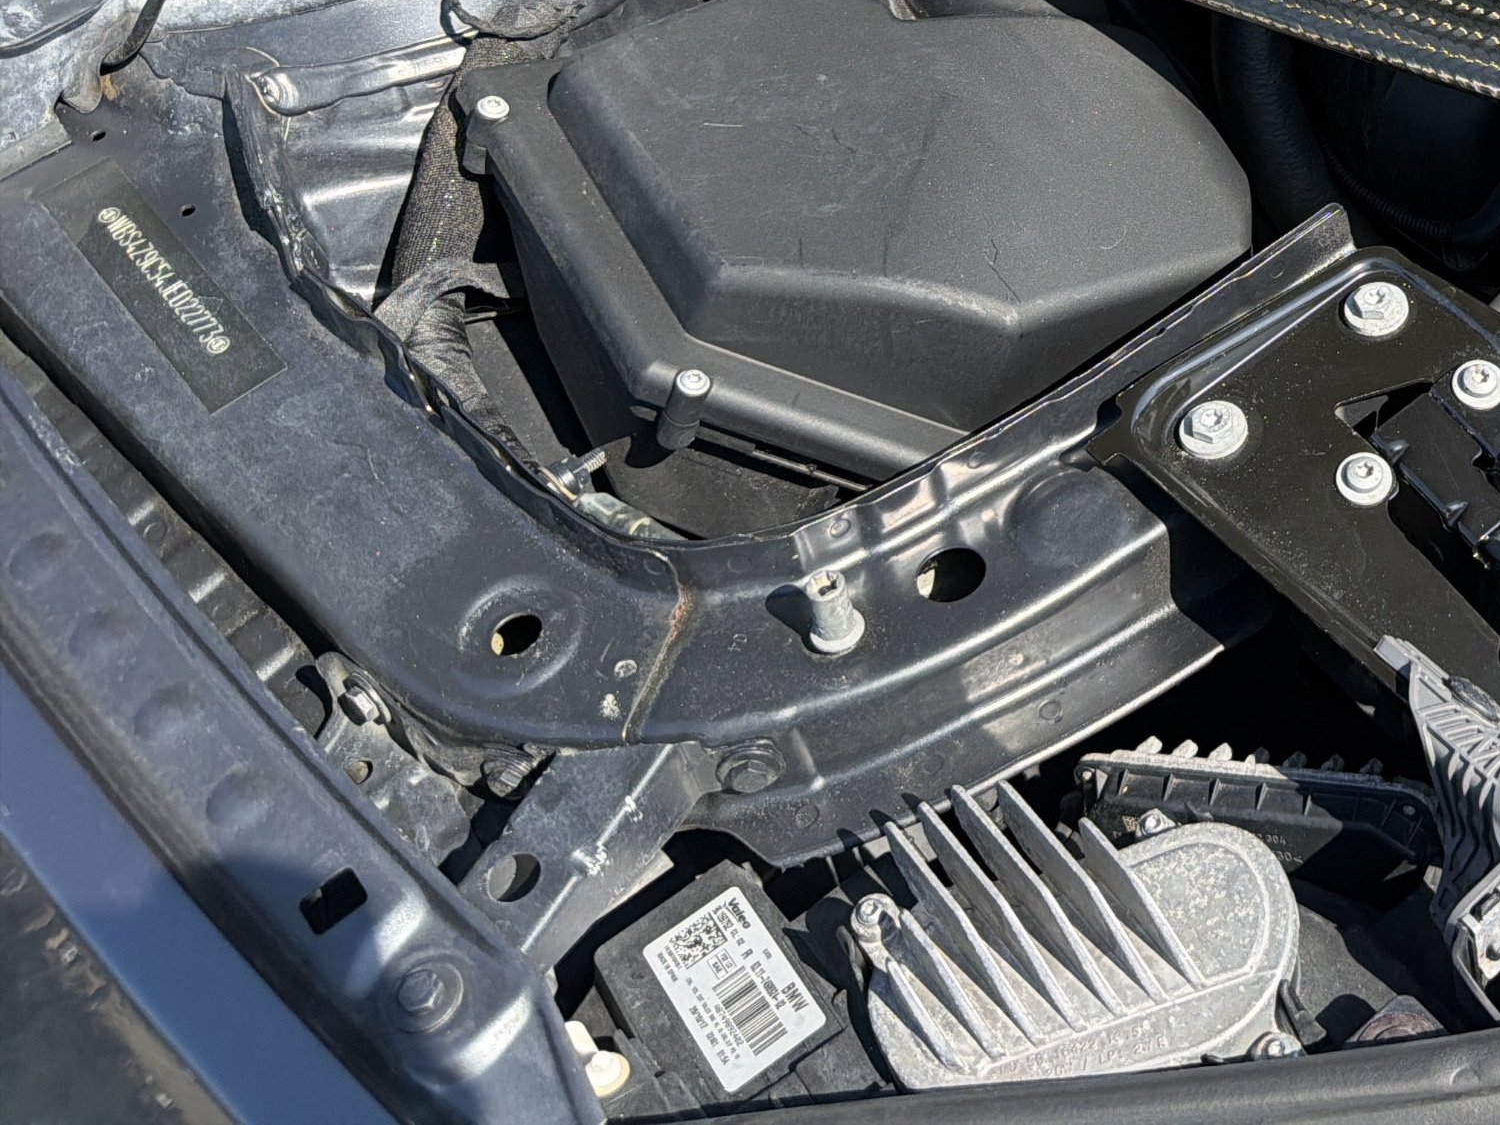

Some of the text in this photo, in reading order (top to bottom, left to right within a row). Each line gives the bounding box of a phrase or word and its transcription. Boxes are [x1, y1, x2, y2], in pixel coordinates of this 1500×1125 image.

[726, 896, 753, 930] Valeo
[740, 947, 754, 960] R
[780, 981, 809, 1013] BMW
